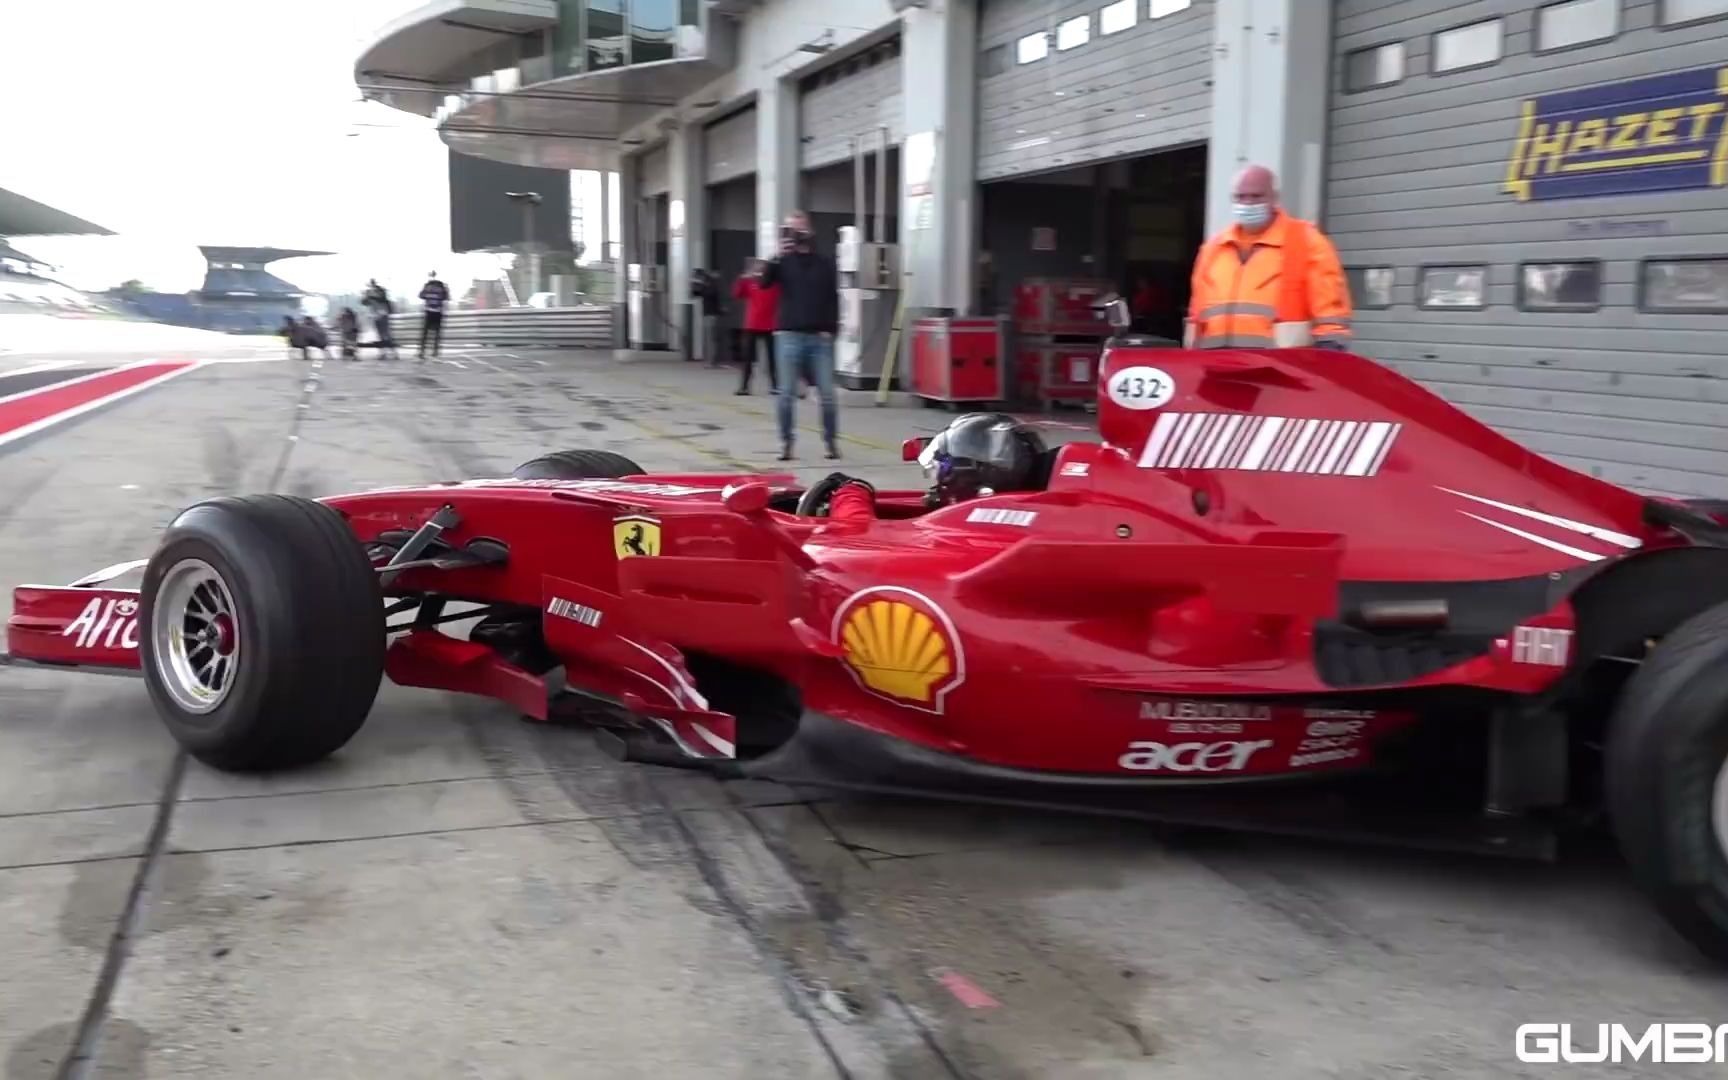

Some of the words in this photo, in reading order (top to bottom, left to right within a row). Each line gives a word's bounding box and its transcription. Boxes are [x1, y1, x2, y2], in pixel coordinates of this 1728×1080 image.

[1523, 102, 1725, 175] HAZET
[62, 597, 139, 649] Alic
[1118, 739, 1273, 771] acer
